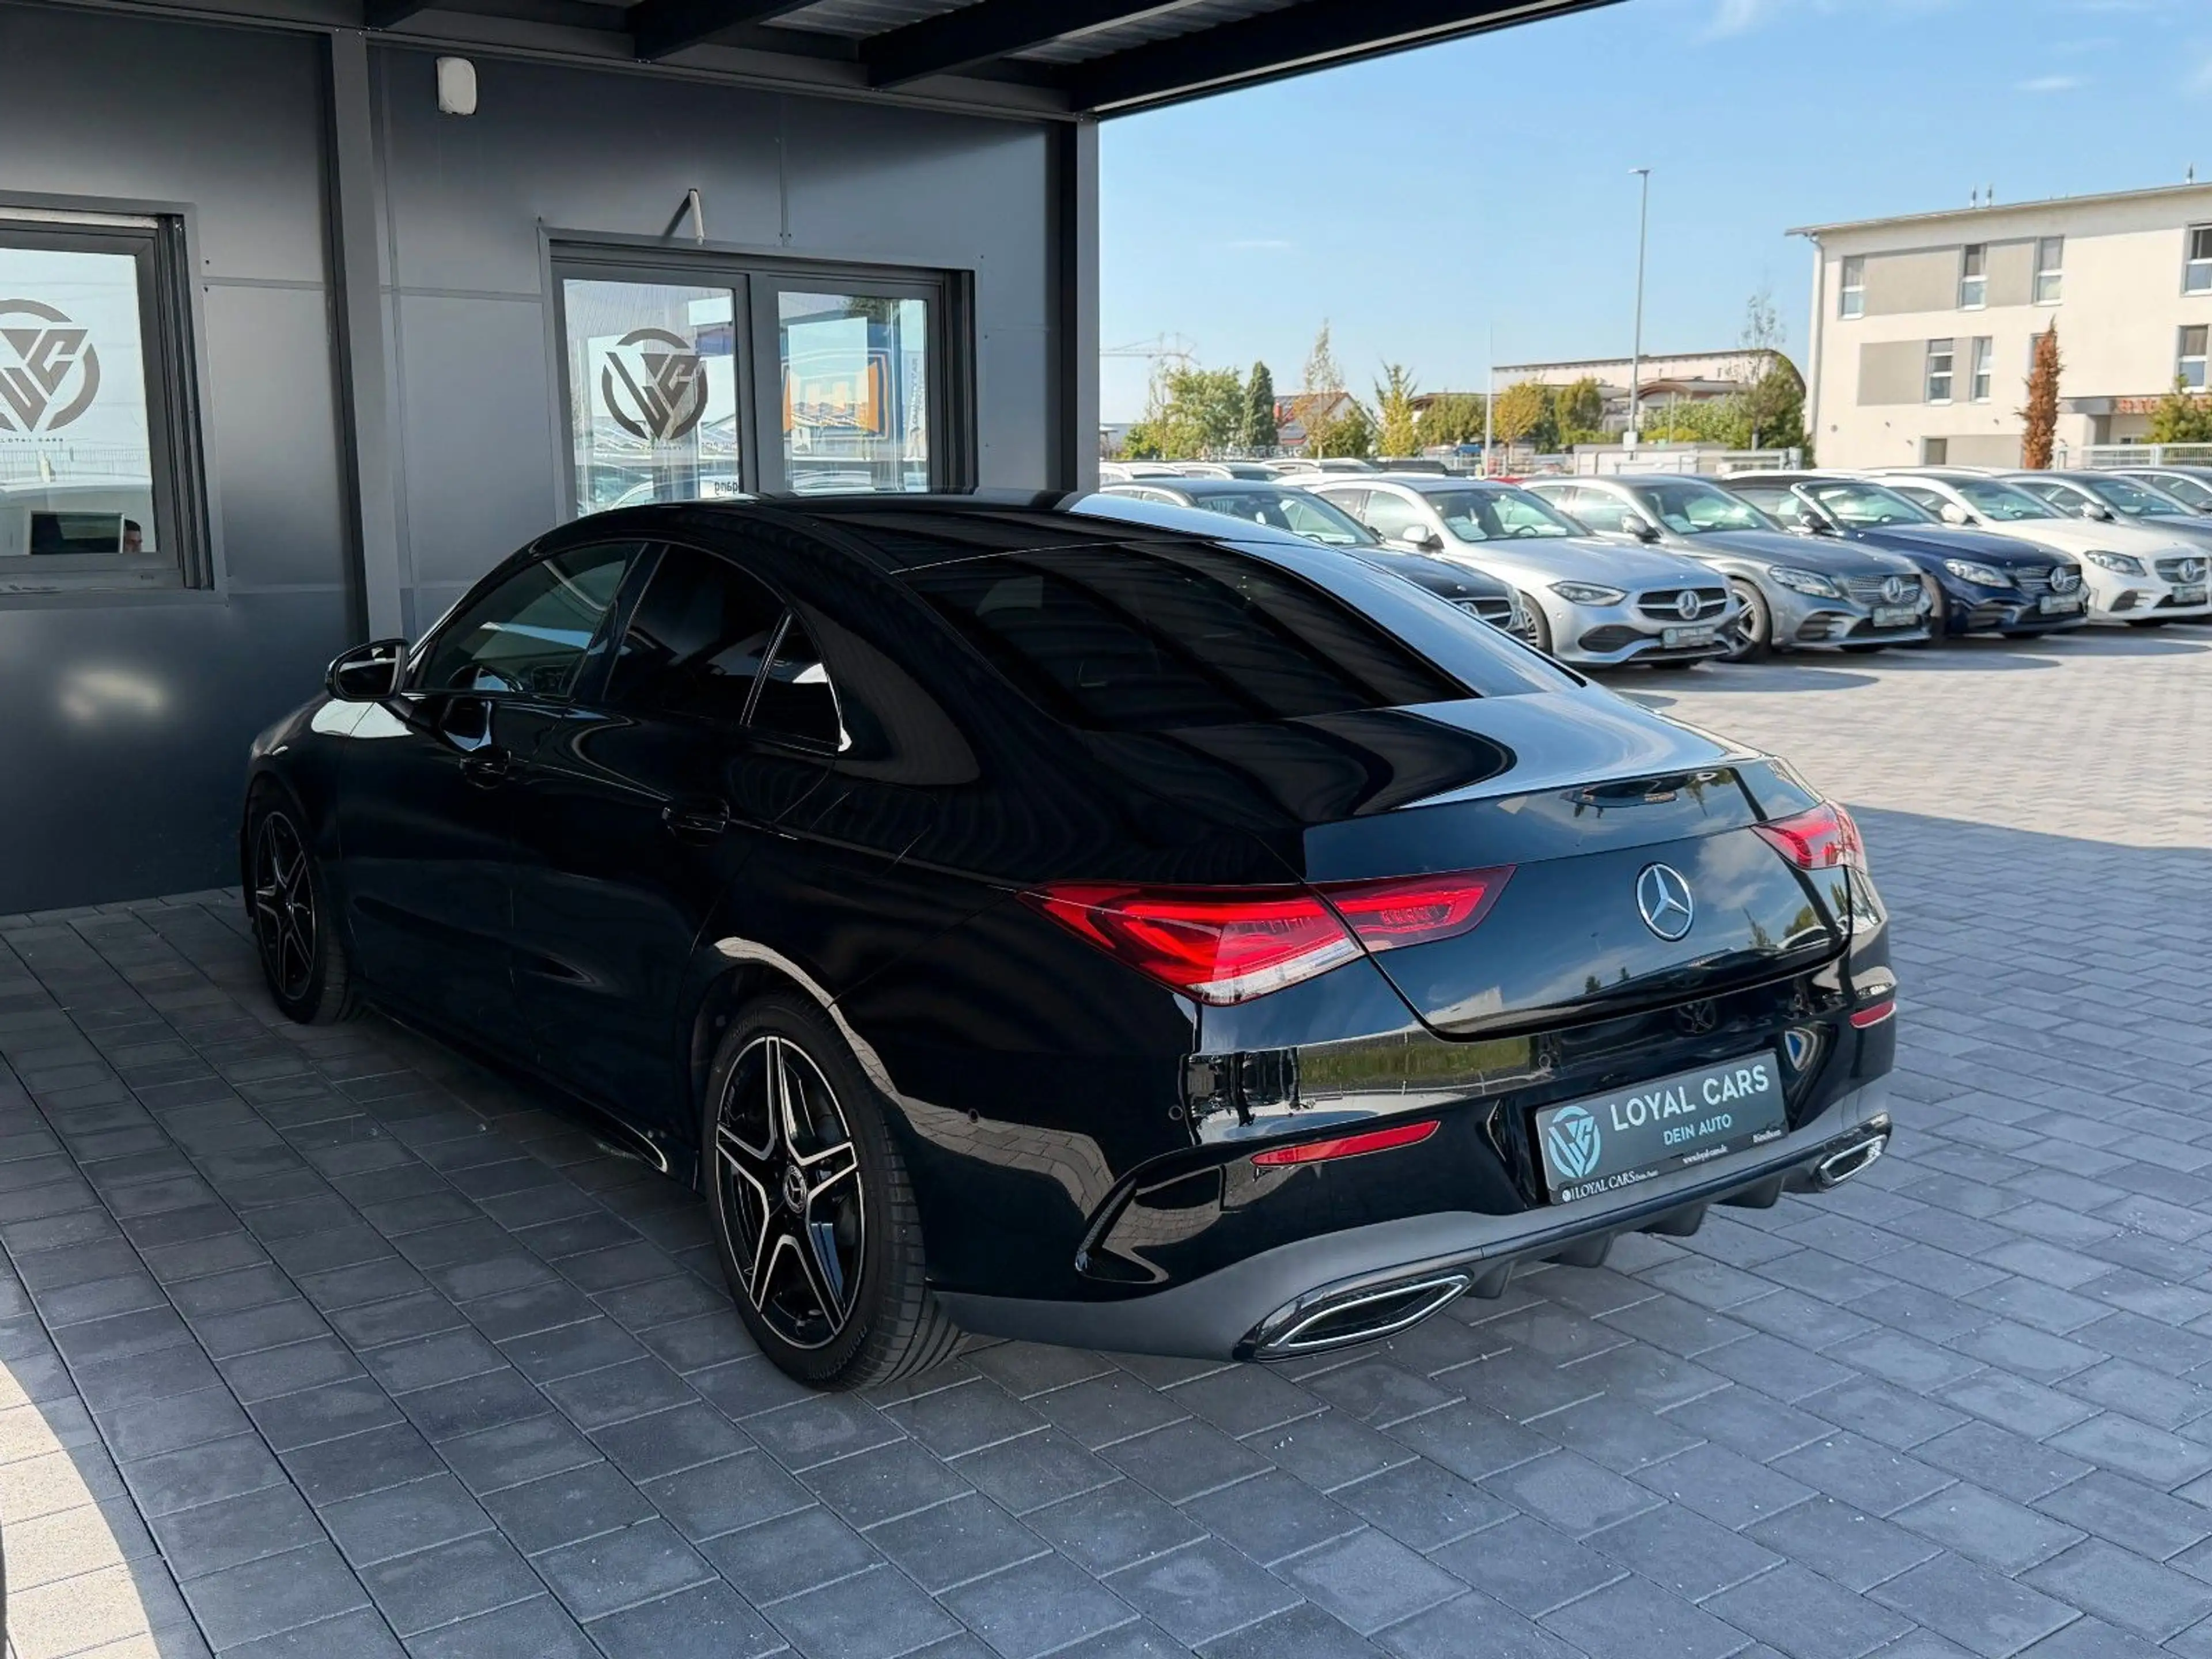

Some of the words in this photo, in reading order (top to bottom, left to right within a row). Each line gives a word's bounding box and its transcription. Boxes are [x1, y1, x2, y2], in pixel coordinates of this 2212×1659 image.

[1610, 1086, 1696, 1131] LOYAL
[1703, 1065, 1770, 1105] CARS
[1664, 1123, 1695, 1146] DEIN
[1698, 1113, 1732, 1135] AUTO
[1575, 1180, 1608, 1199] LOYAL
[1609, 1171, 1635, 1188] CARS
